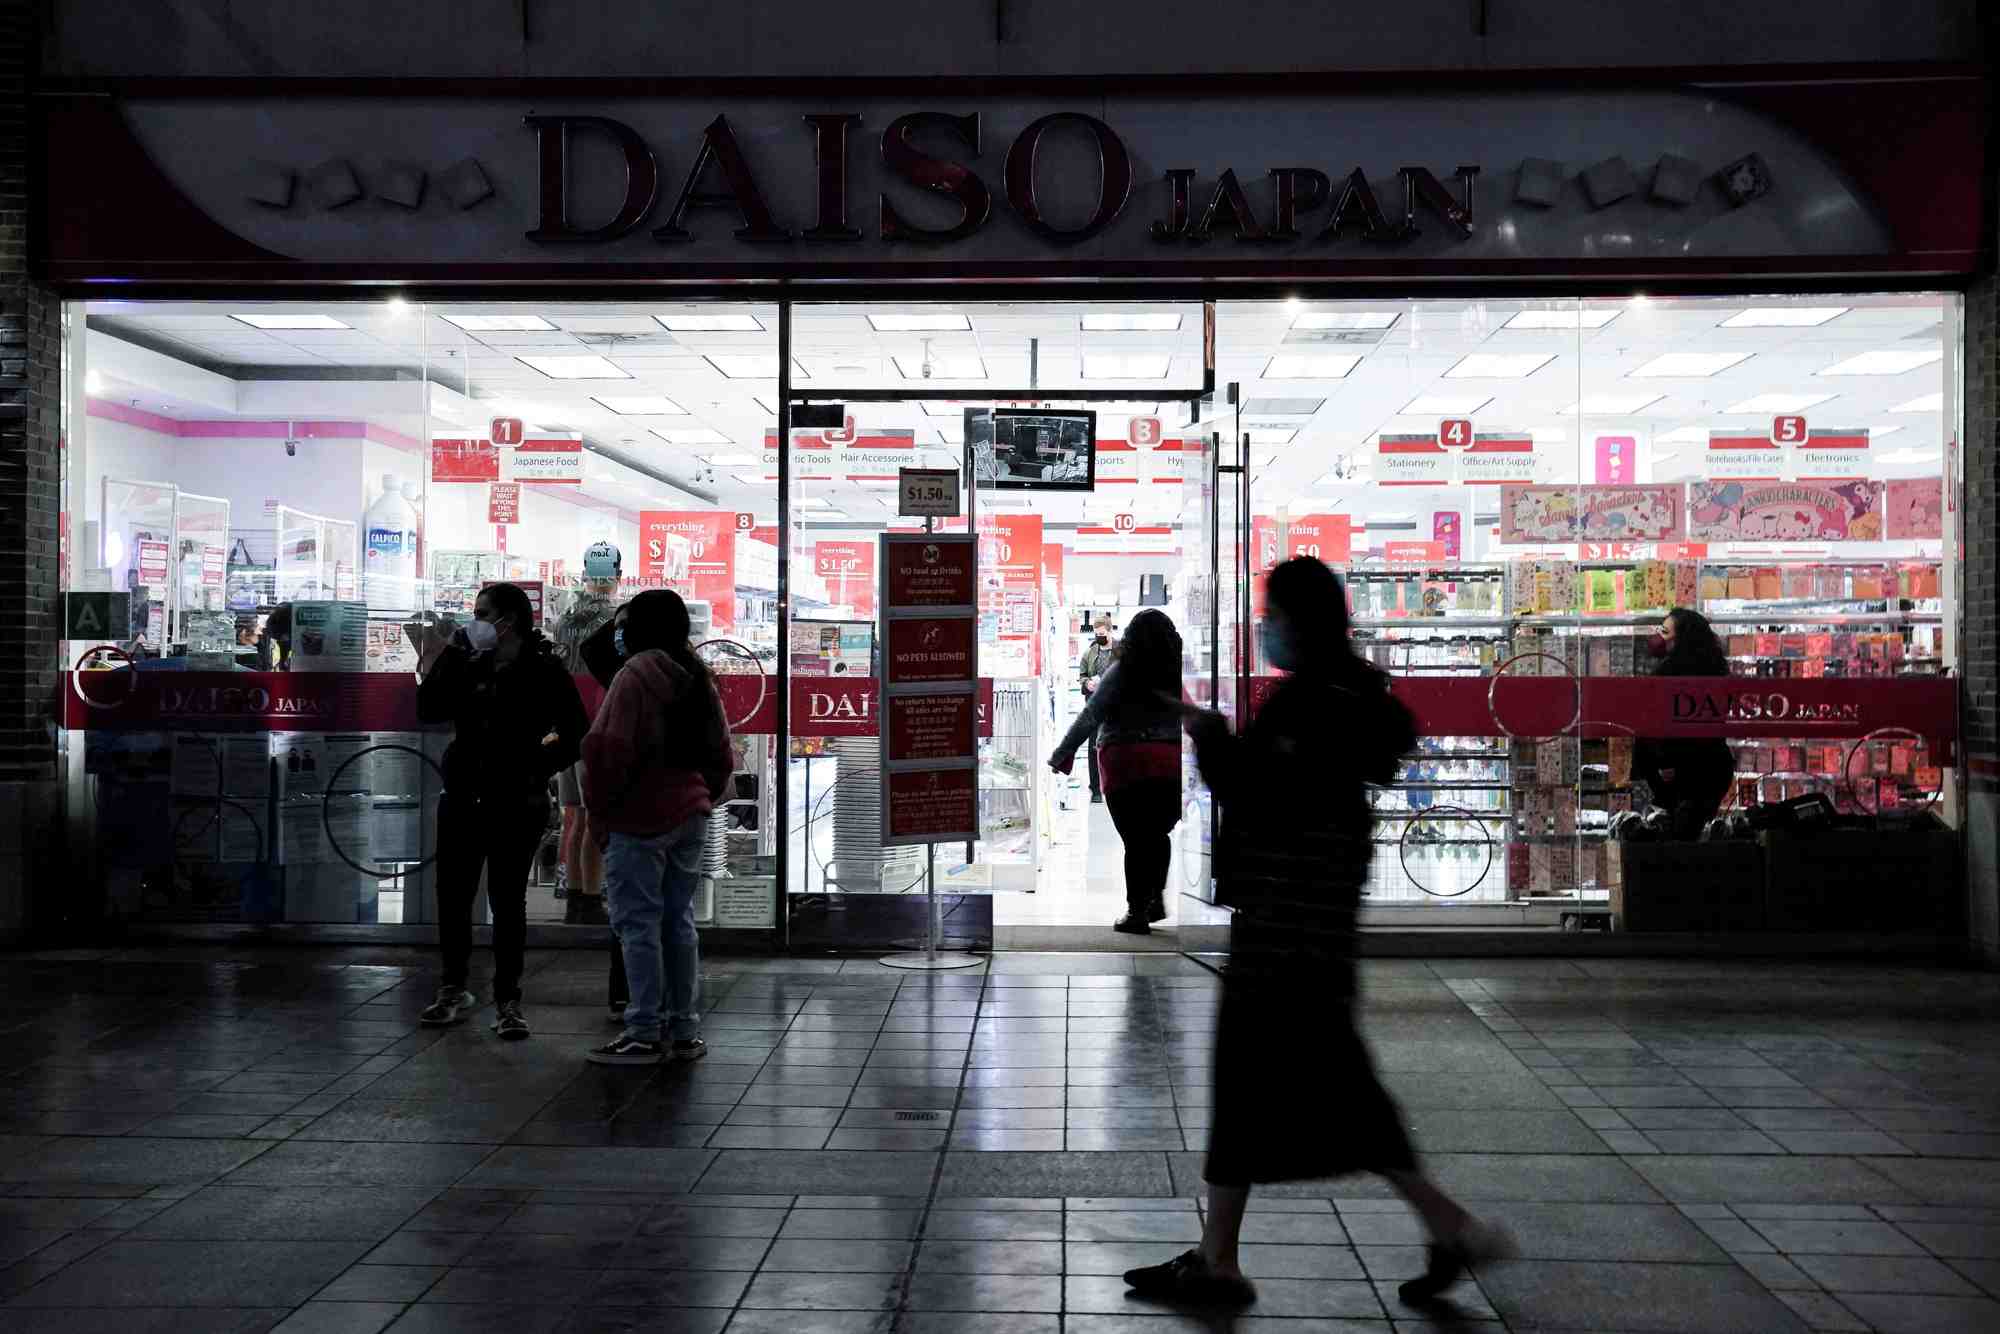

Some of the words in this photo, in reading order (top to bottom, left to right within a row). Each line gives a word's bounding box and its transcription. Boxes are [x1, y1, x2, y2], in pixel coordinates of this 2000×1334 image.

[525, 110, 1134, 244] DAISO
[1147, 164, 1482, 242] JAPAN
[501, 421, 511, 441] 1
[1136, 420, 1152, 441] 3
[1448, 423, 1463, 444] 4
[1782, 419, 1797, 438] 5
[513, 456, 554, 469] Japanese
[556, 456, 578, 466] Food
[763, 453, 806, 464] Costic
[808, 454, 831, 464] Tools
[841, 453, 859, 463] Hair
[861, 453, 914, 463] Accessories
[1386, 458, 1436, 470] Stationery
[1805, 453, 1860, 463] Electronics
[908, 486, 943, 501] $1.50
[650, 521, 705, 534] everything
[739, 514, 749, 528] 8
[1115, 516, 1133, 530] 10
[371, 533, 400, 543] CALPICO
[74, 605, 101, 632] A
[896, 653, 909, 663] NO
[930, 651, 966, 662] ALLOWED
[160, 687, 271, 712] DAISO
[809, 693, 869, 718] DAI
[1672, 692, 1791, 719] DAISO
[1795, 703, 1860, 719] JAPAN
